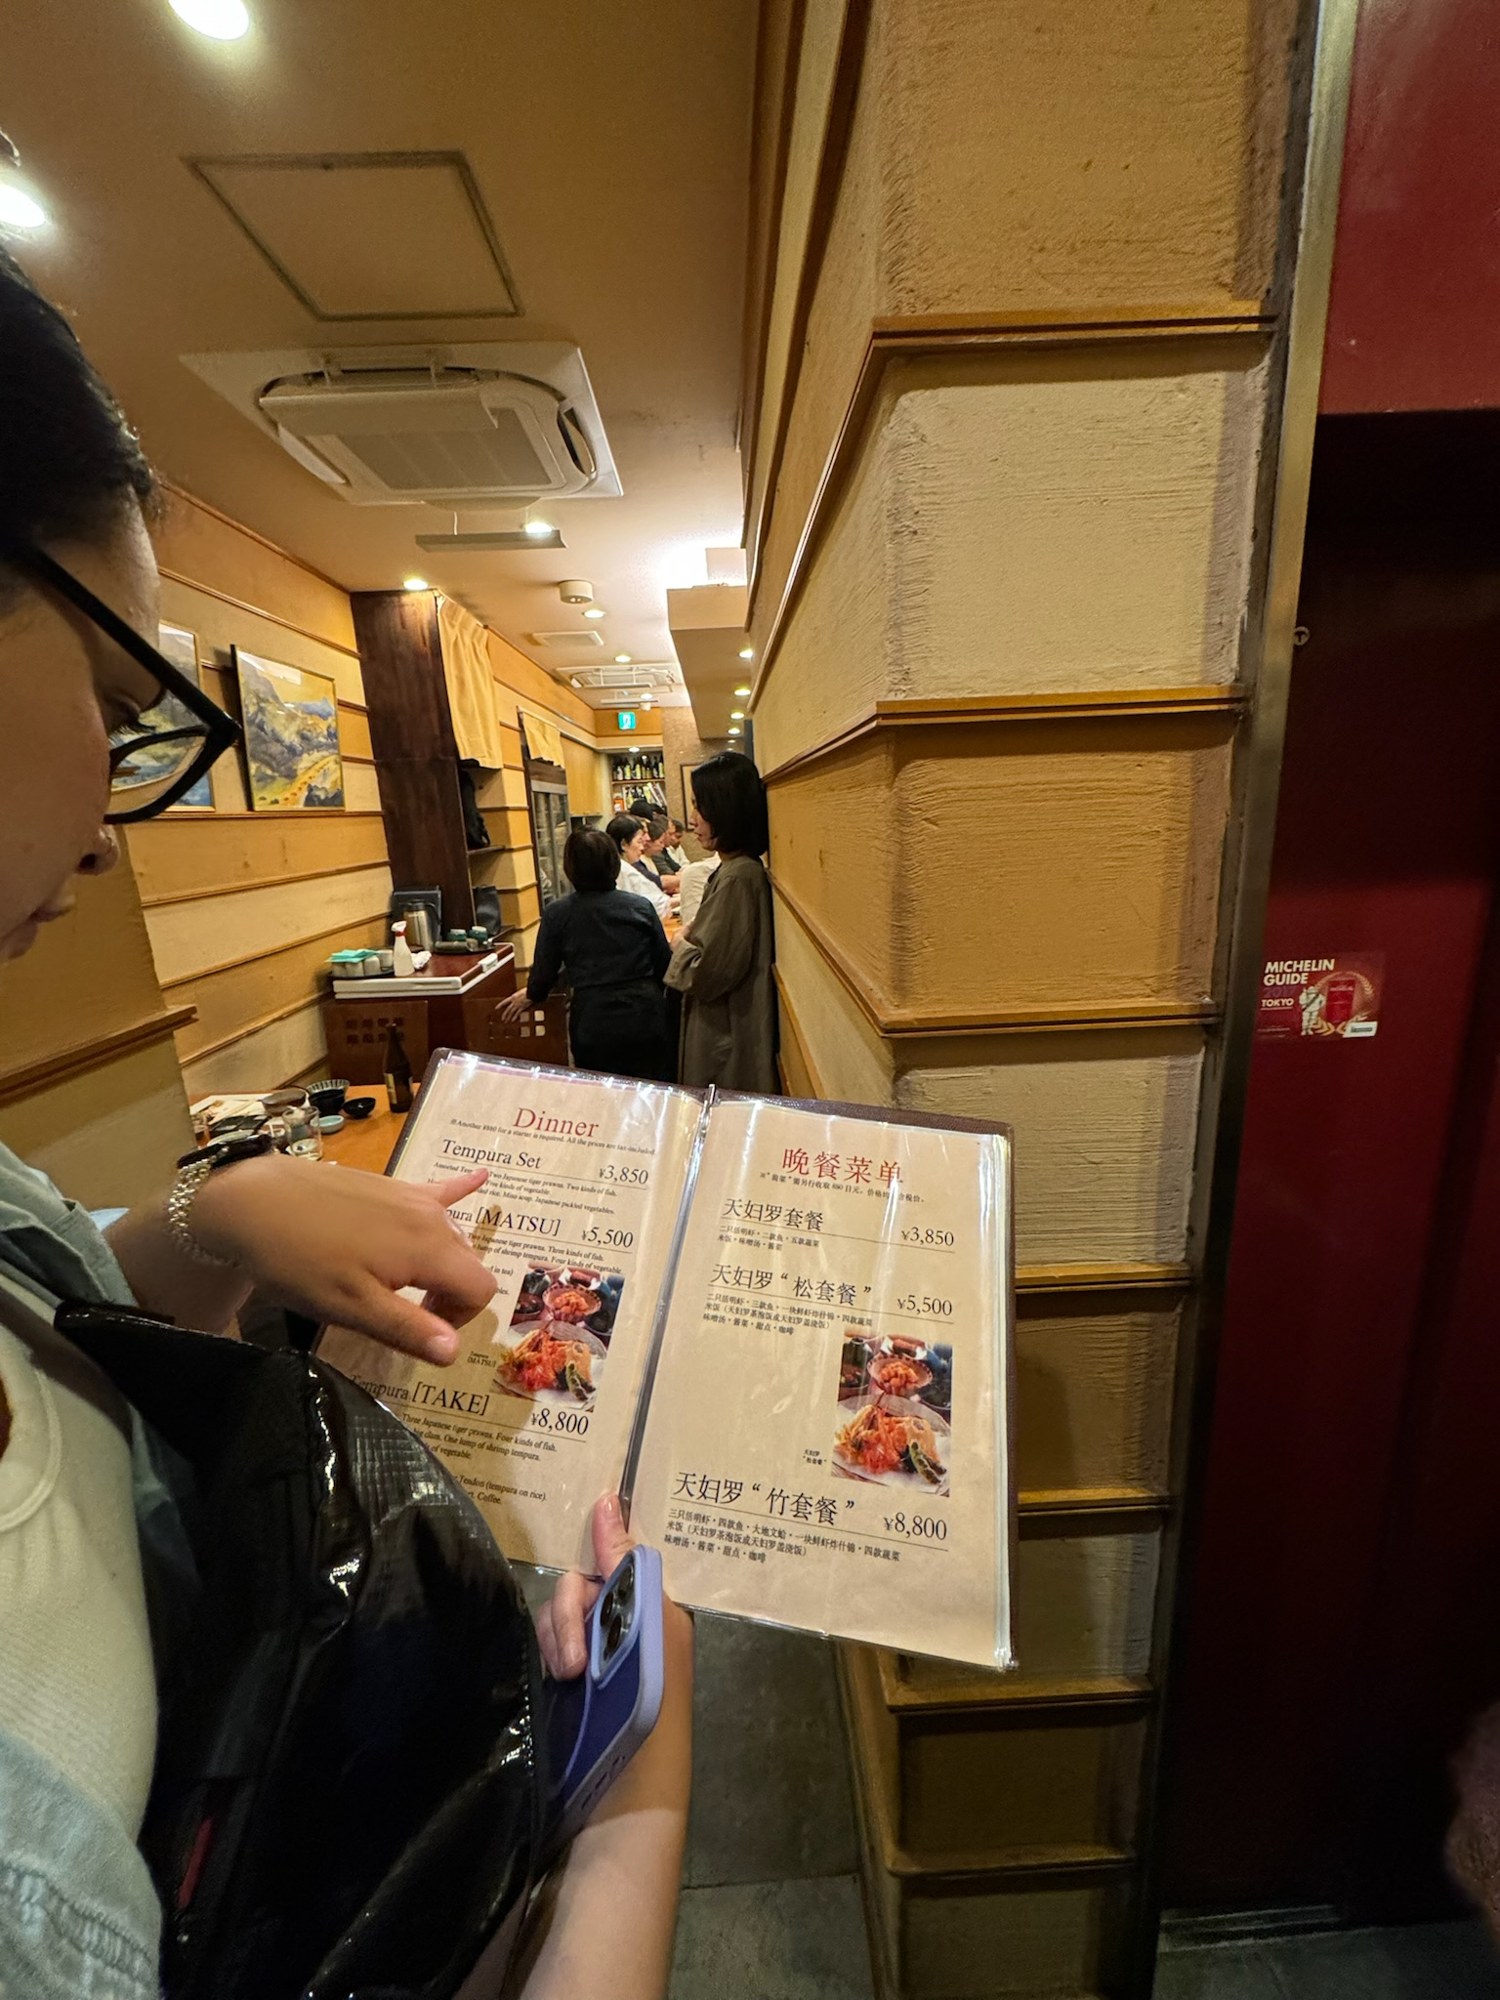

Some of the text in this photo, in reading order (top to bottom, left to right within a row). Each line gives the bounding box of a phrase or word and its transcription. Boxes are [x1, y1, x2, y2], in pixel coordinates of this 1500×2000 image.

[1265, 959, 1335, 973] MICHELIN
[1263, 973, 1309, 986] GUIDE
[1261, 998, 1294, 1007] TOKYO
[513, 1107, 599, 1138] Dinner
[577, 1138, 587, 1146] the
[442, 1139, 649, 1184] Tempura Set ¥3,850
[782, 1147, 904, 1189] 晚餐菜单
[499, 1181, 515, 1190] kinds
[503, 1172, 527, 1182] Japanese
[566, 1183, 580, 1191] Two
[580, 1185, 597, 1193] kinds
[535, 1195, 560, 1206] Japanese
[475, 1206, 561, 1236] [MATSU]
[582, 1226, 634, 1248] ¥5,500
[722, 1198, 955, 1246] 天妇罗套餐 ¥3,850
[493, 1246, 501, 1254] of
[501, 1248, 522, 1258] shrimp
[551, 1255, 566, 1264] Four
[567, 1258, 584, 1268] kinds
[585, 1261, 593, 1269] of
[508, 1239, 522, 1248] tiger
[566, 1248, 582, 1258] kinds
[583, 1251, 591, 1259] of
[896, 1294, 952, 1317] ¥5,500
[412, 1381, 489, 1416] [TAKE]
[531, 1408, 589, 1435] ¥8,800
[422, 1417, 451, 1430] Japanese
[496, 1432, 513, 1443] Four
[514, 1436, 533, 1447] kinds
[534, 1441, 543, 1449] of
[543, 1442, 557, 1452] fish.
[443, 1434, 458, 1443] One
[459, 1437, 476, 1448] lump
[477, 1441, 486, 1449] of
[486, 1444, 510, 1456] shrimp
[511, 1448, 541, 1461] tempura.
[485, 1480, 518, 1495] (tempura
[518, 1487, 529, 1496] on
[883, 1511, 948, 1540] ¥8,800
